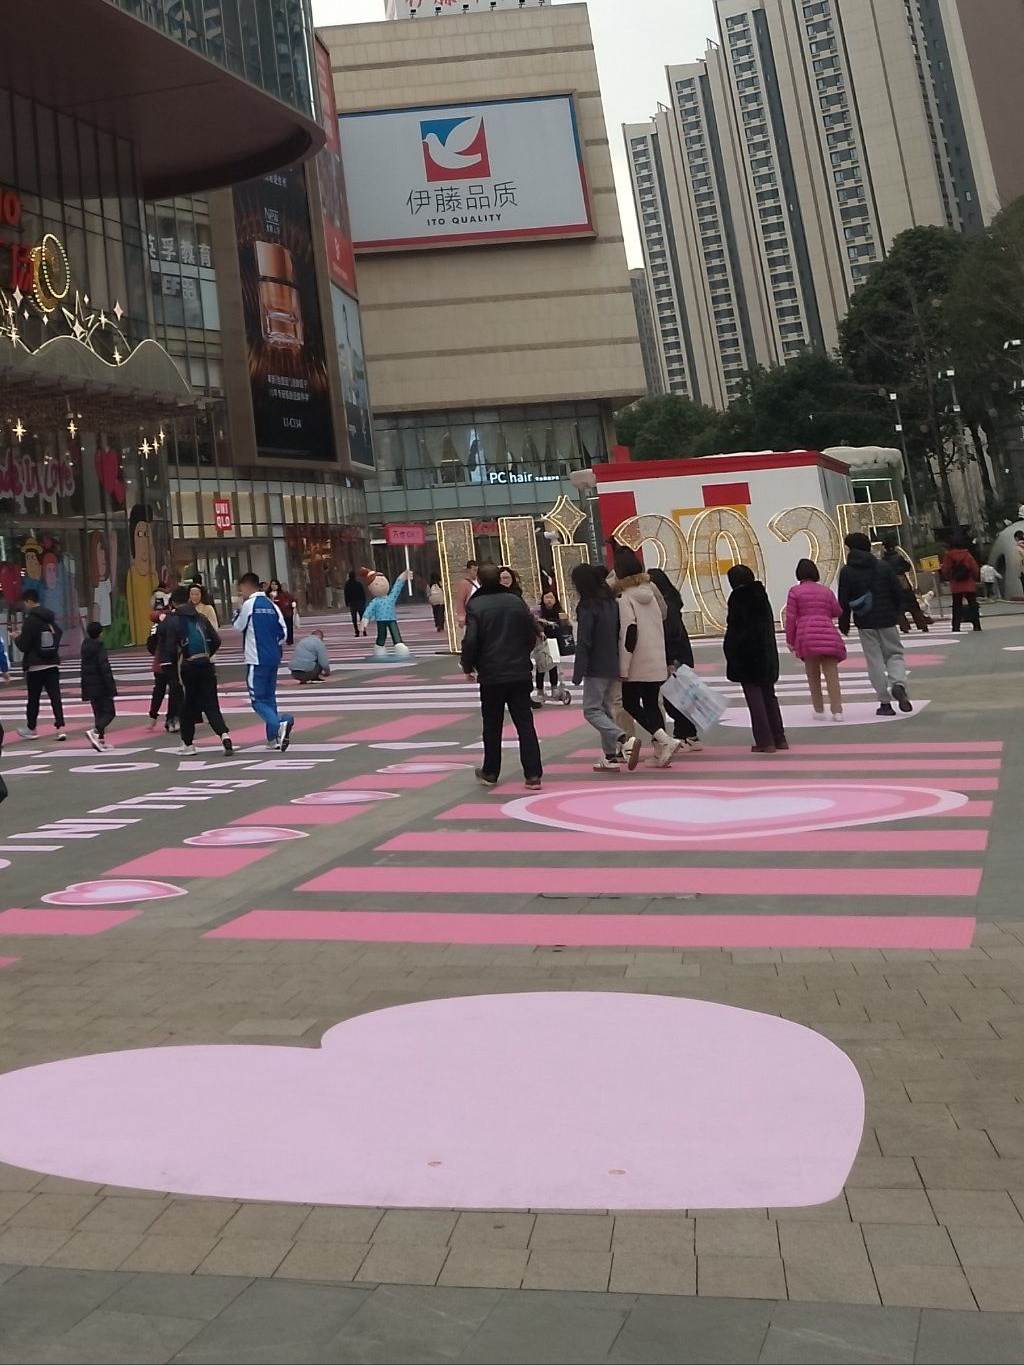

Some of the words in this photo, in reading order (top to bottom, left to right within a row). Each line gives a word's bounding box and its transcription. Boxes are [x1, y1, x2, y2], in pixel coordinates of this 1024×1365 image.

[406, 181, 518, 215] 伊藤品质
[427, 217, 446, 226] ITO
[452, 213, 502, 225] QUALITY
[489, 471, 507, 484] PC
[509, 471, 533, 483] hair
[215, 503, 229, 514] UNI
[216, 516, 231, 528] QLO
[1, 758, 336, 774] LOVE
[87, 779, 268, 814] FALL
[7, 818, 143, 839] IN
